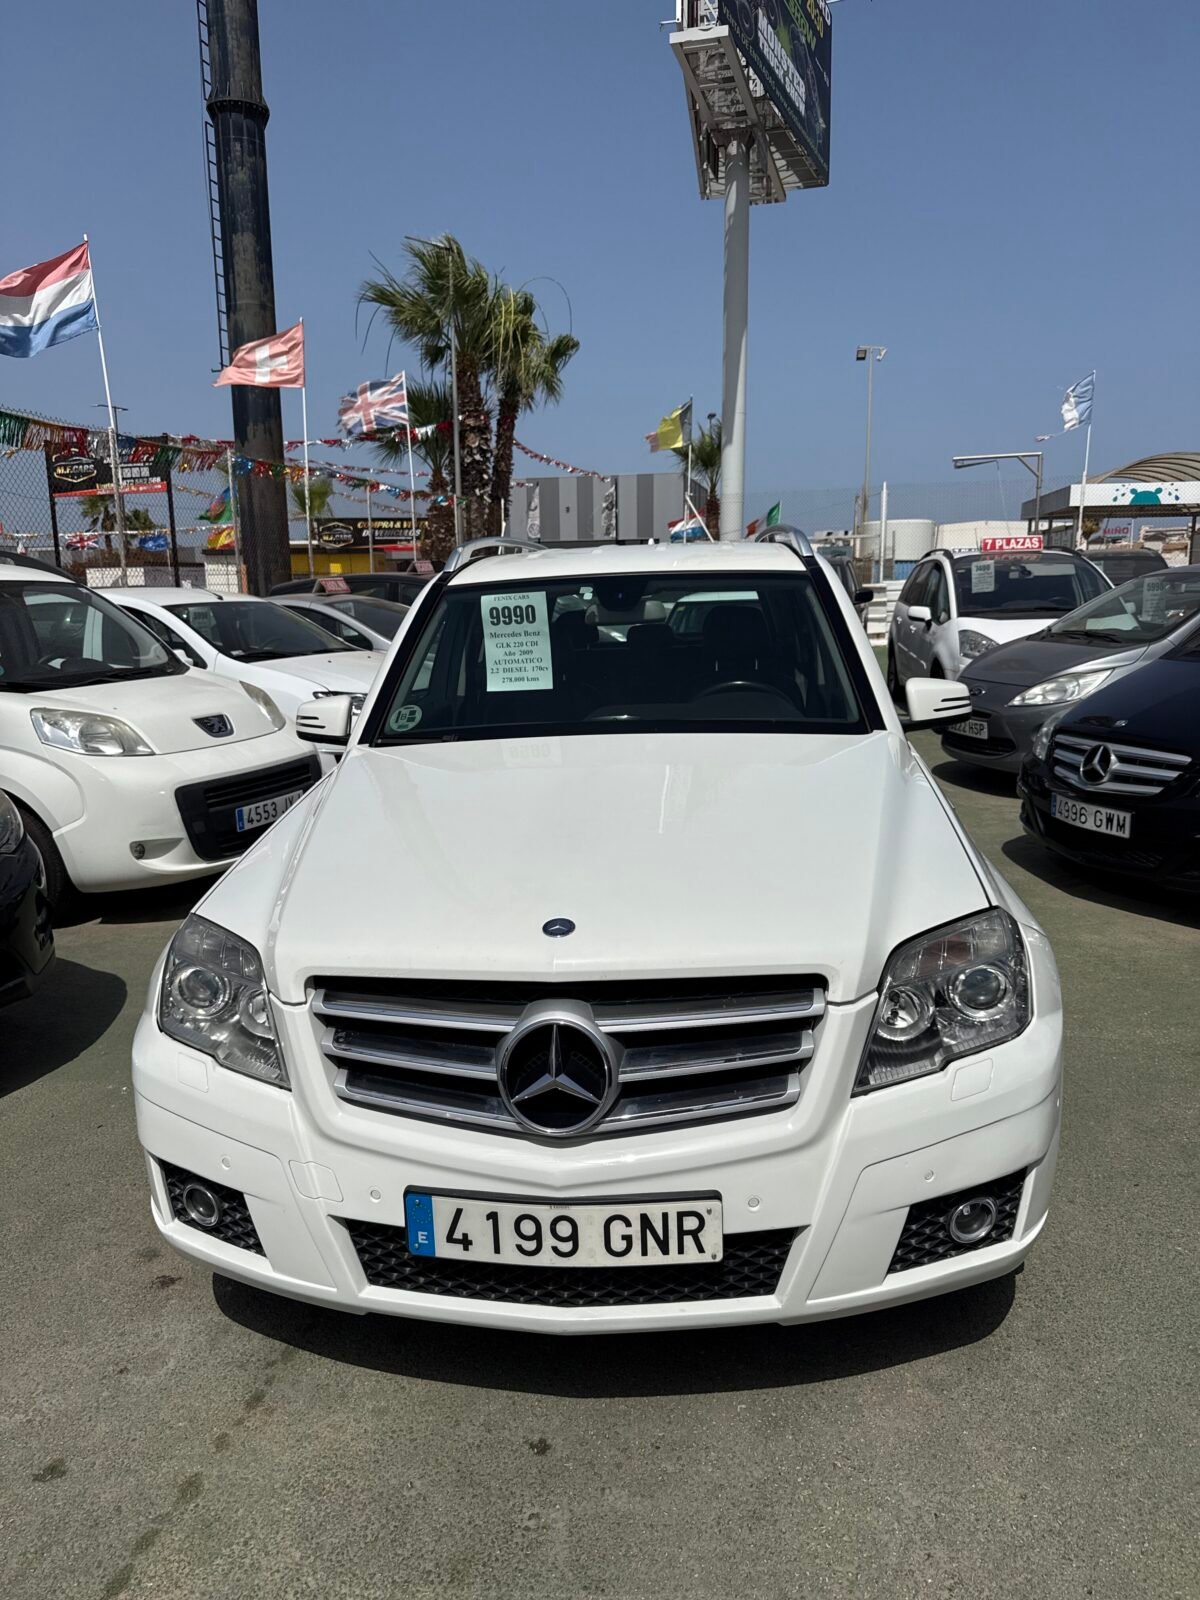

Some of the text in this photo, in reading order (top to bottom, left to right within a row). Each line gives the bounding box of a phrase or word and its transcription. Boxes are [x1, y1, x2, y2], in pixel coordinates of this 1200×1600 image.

[758, 7, 806, 102] MONSTER
[758, 30, 784, 84] TRUCK
[785, 76, 805, 117] SHOW
[985, 539, 993, 550] 7
[995, 537, 1040, 549] PLAZAS
[489, 604, 536, 626] 9990
[489, 631, 522, 639] Mercedes
[493, 657, 543, 666] AUTOMATICO
[968, 721, 985, 736] HSP
[247, 801, 278, 824] 4553
[1057, 799, 1126, 834] 4996 GWM
[417, 1207, 707, 1257] E 4199 GNR
